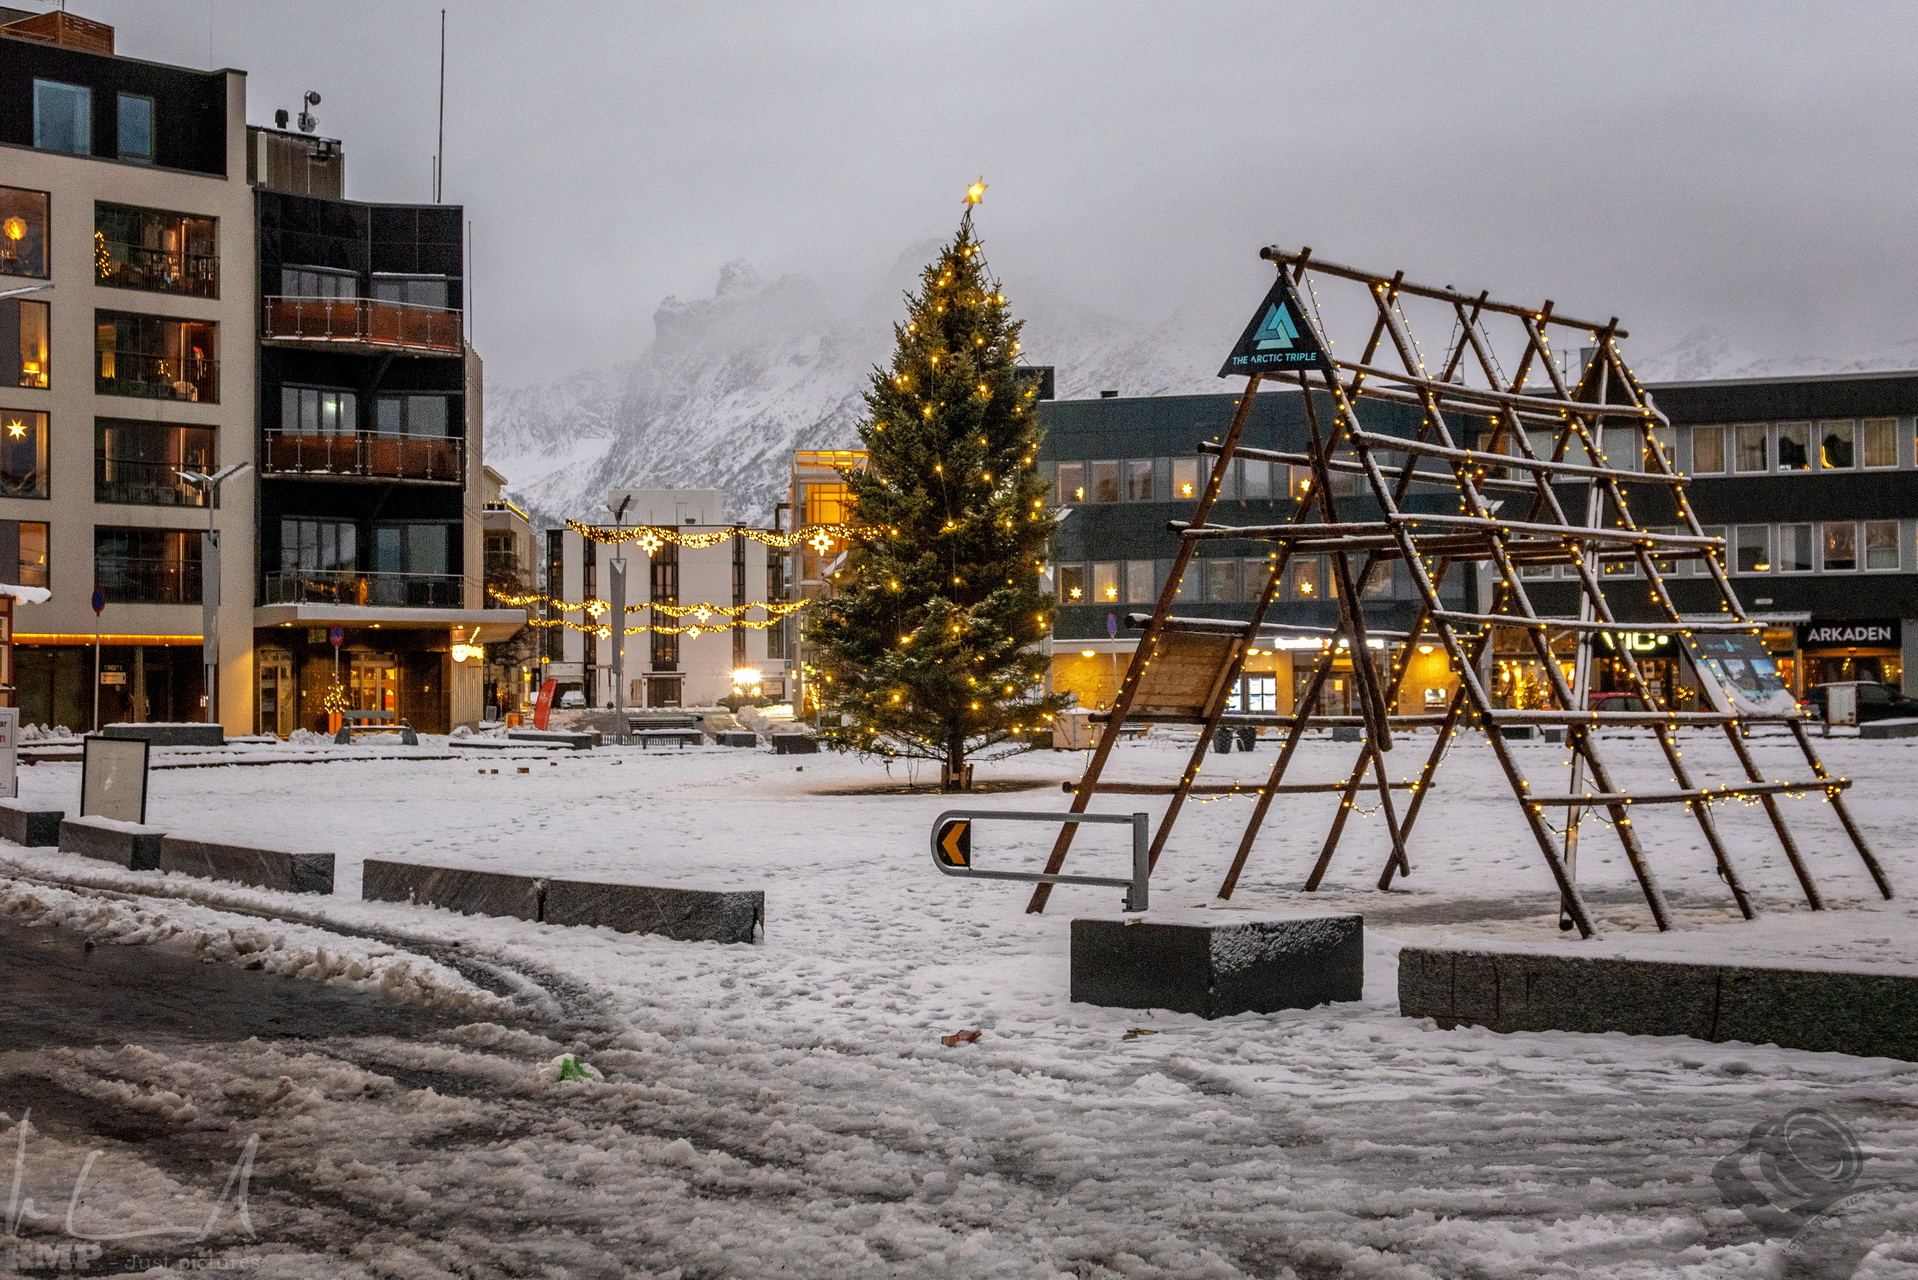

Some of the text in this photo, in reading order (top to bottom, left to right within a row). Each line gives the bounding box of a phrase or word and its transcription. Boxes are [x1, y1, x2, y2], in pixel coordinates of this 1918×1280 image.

[1232, 352, 1317, 365] THE ARCTIC TRIPLE
[1807, 626, 1891, 641] ARKADEN
